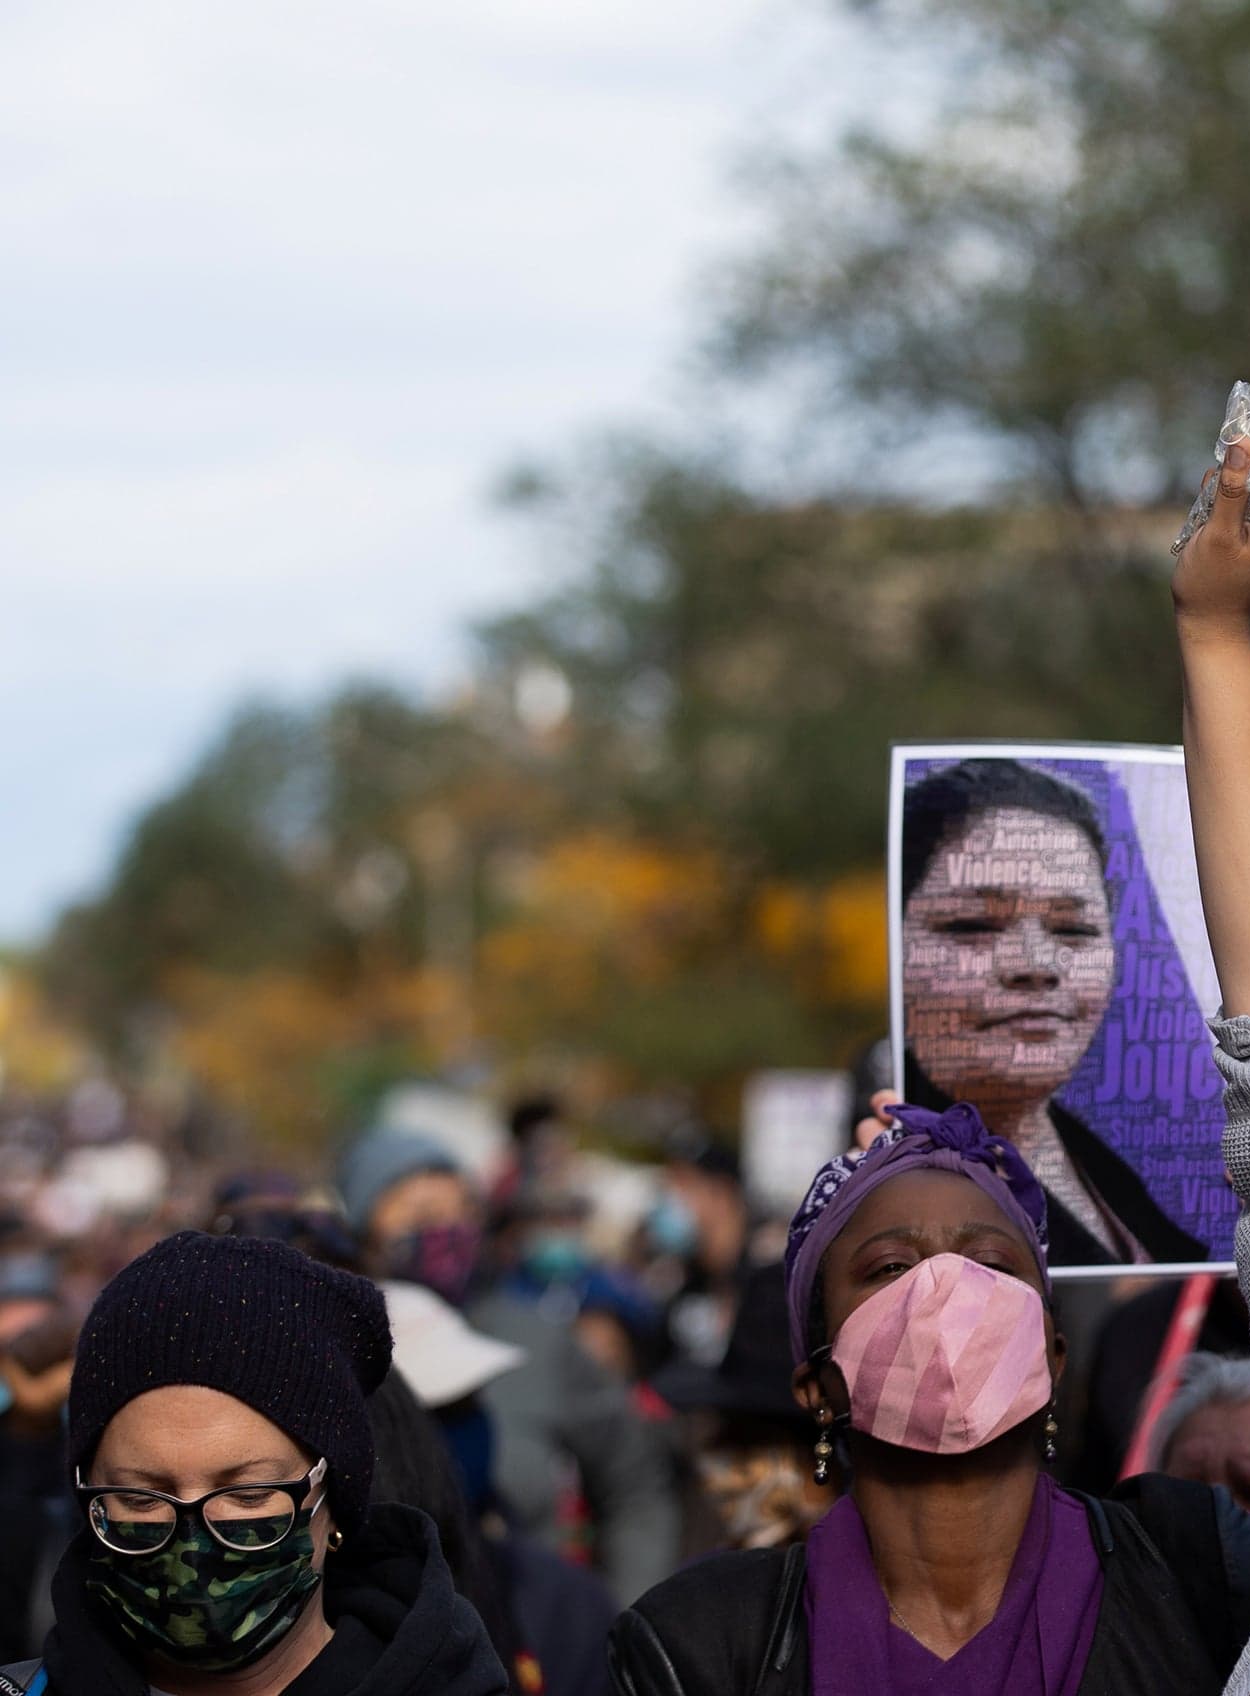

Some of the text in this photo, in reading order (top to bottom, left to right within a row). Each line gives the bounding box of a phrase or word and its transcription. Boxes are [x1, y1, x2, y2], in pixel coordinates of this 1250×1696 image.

[948, 852, 1043, 887] Violence
[1013, 1042, 1057, 1064] Assez
[1096, 1022, 1222, 1118] Joyc
